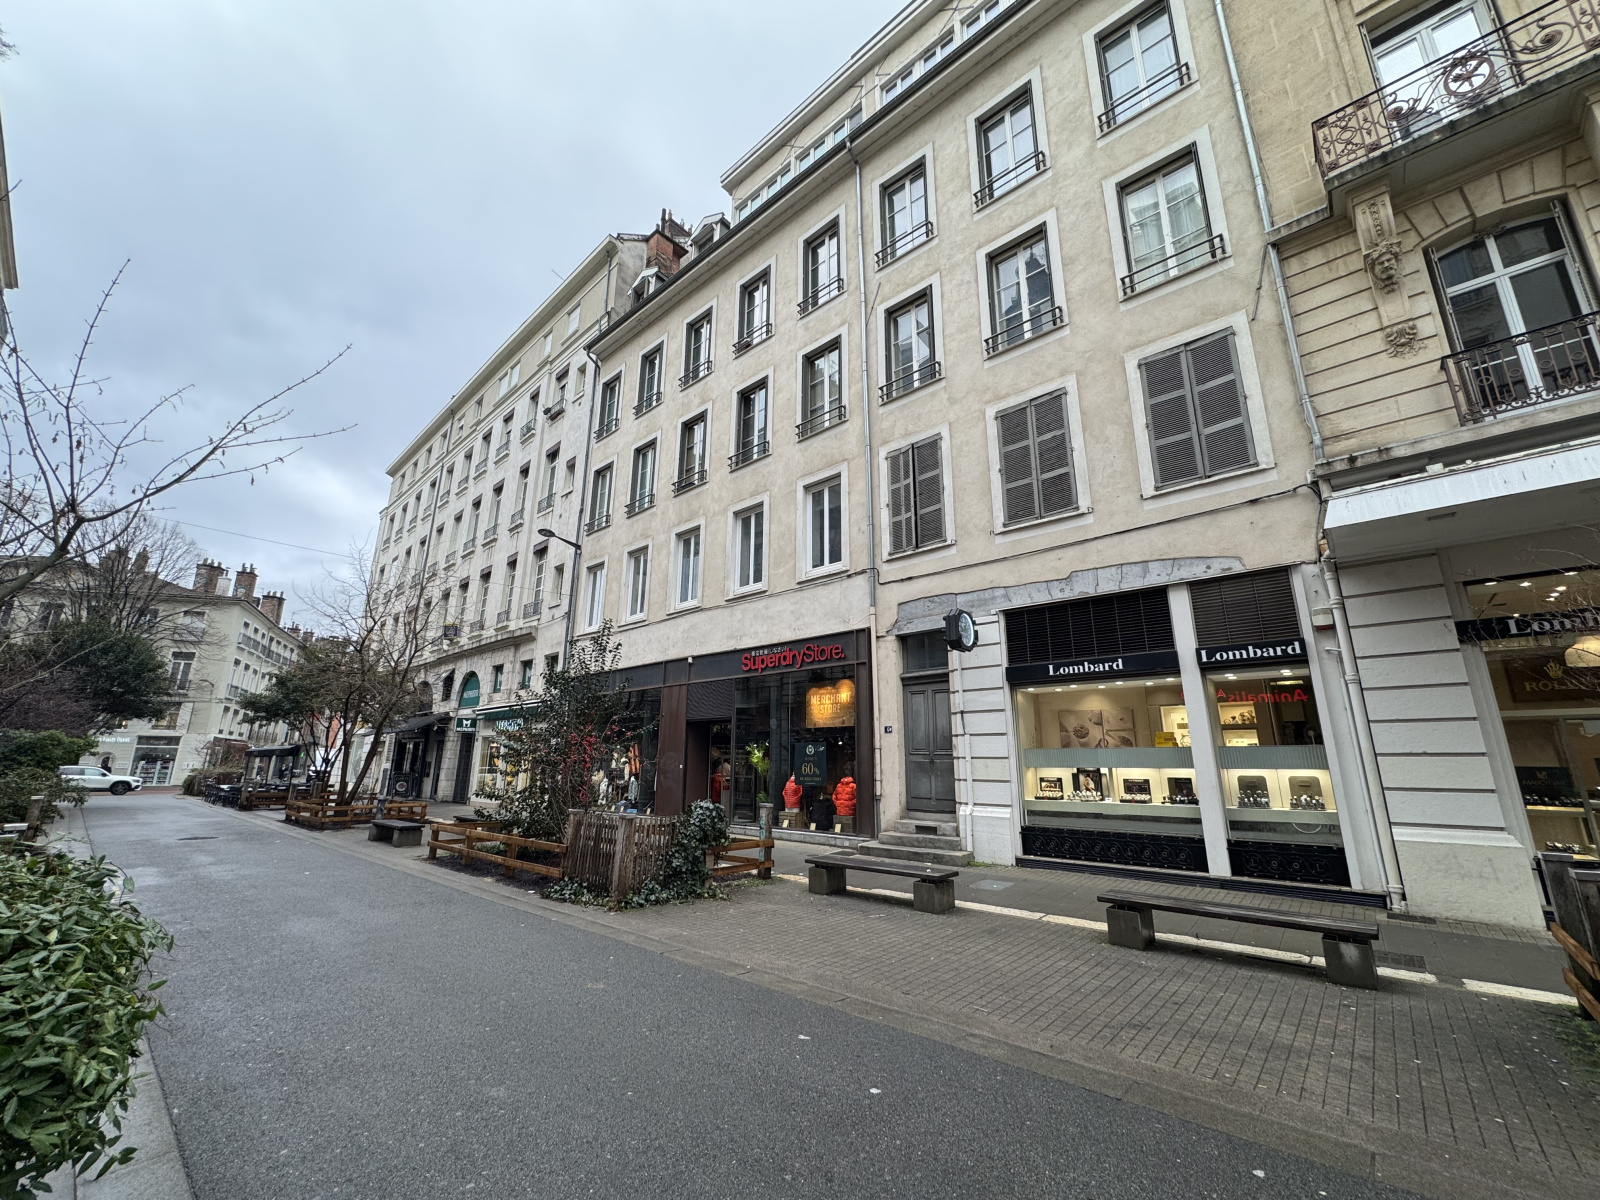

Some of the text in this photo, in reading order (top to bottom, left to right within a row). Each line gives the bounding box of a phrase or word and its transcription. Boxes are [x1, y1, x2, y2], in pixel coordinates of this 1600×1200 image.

[1200, 641, 1302, 662] Lombard
[1048, 658, 1124, 676] Lombard
[810, 691, 852, 705] MERCHANT
[819, 703, 841, 714] STORE
